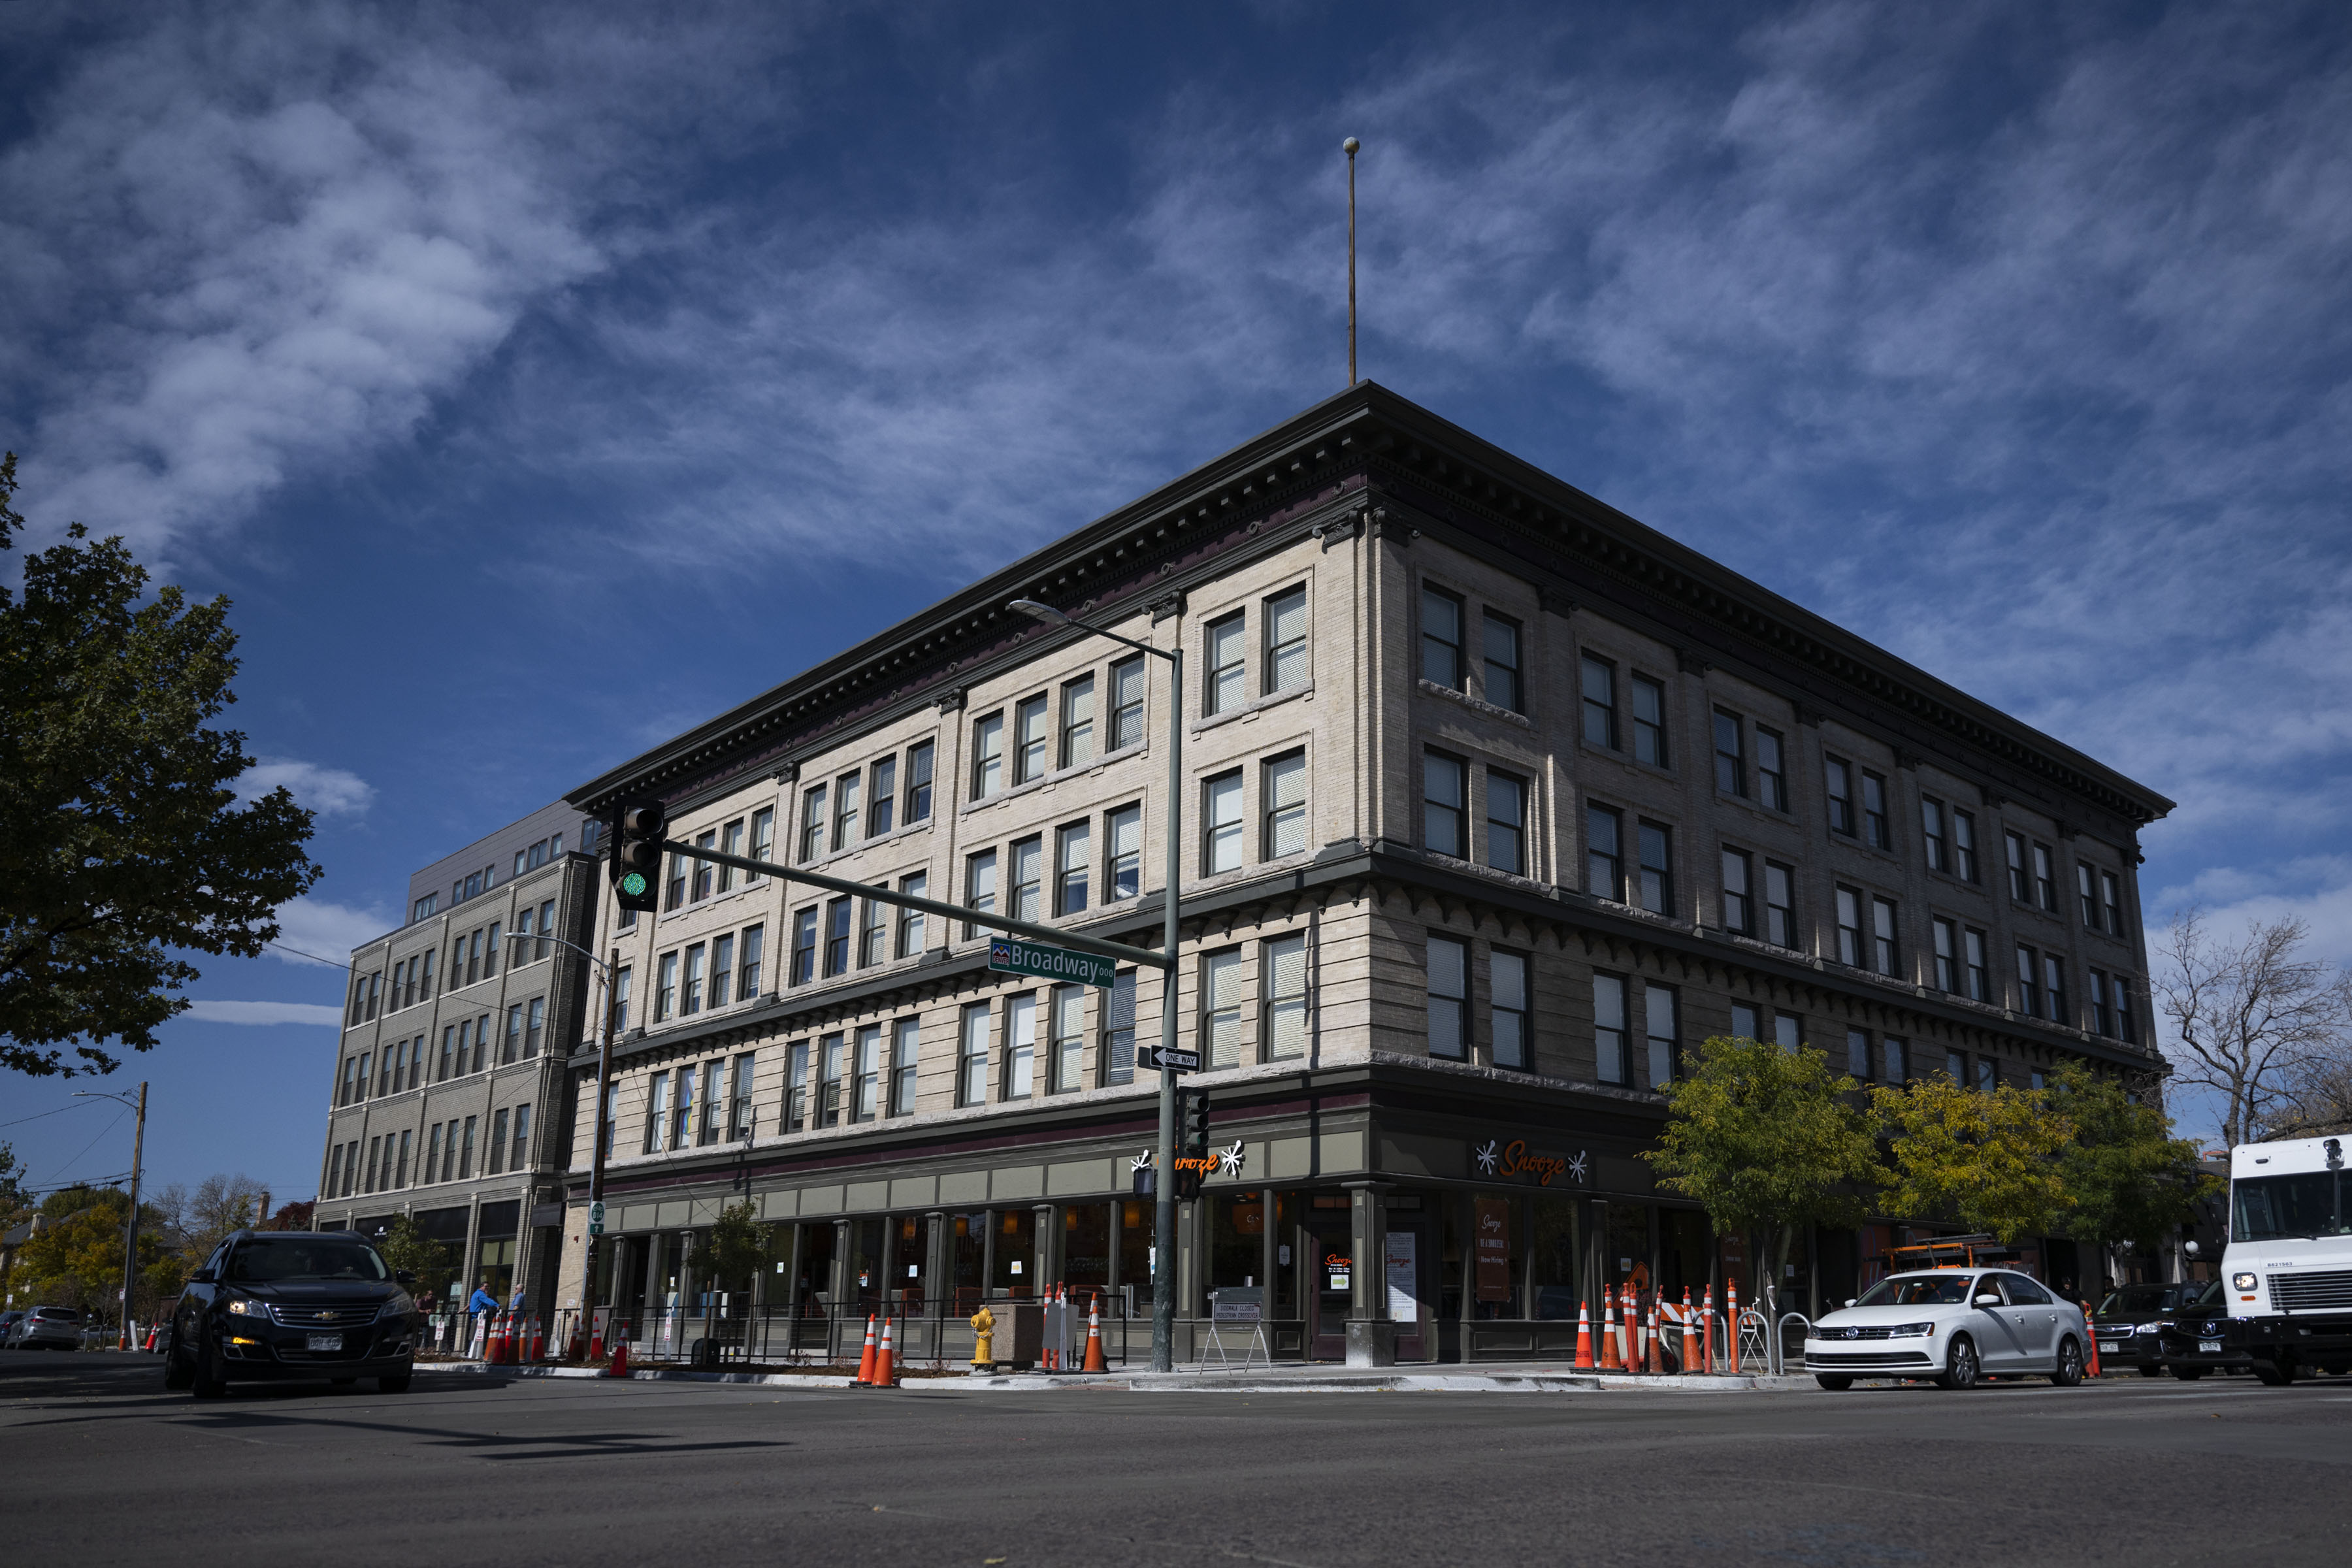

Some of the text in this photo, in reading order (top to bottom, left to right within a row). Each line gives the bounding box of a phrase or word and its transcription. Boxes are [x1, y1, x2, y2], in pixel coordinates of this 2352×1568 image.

[992, 956, 1009, 964] DENVER
[1011, 945, 1098, 983] Broadway
[1166, 1053, 1195, 1065] ONE WAY
[1499, 1139, 1566, 1186] Snooze
[1481, 1214, 1501, 1233] Snooze
[1491, 1256, 1504, 1266] Hiring
